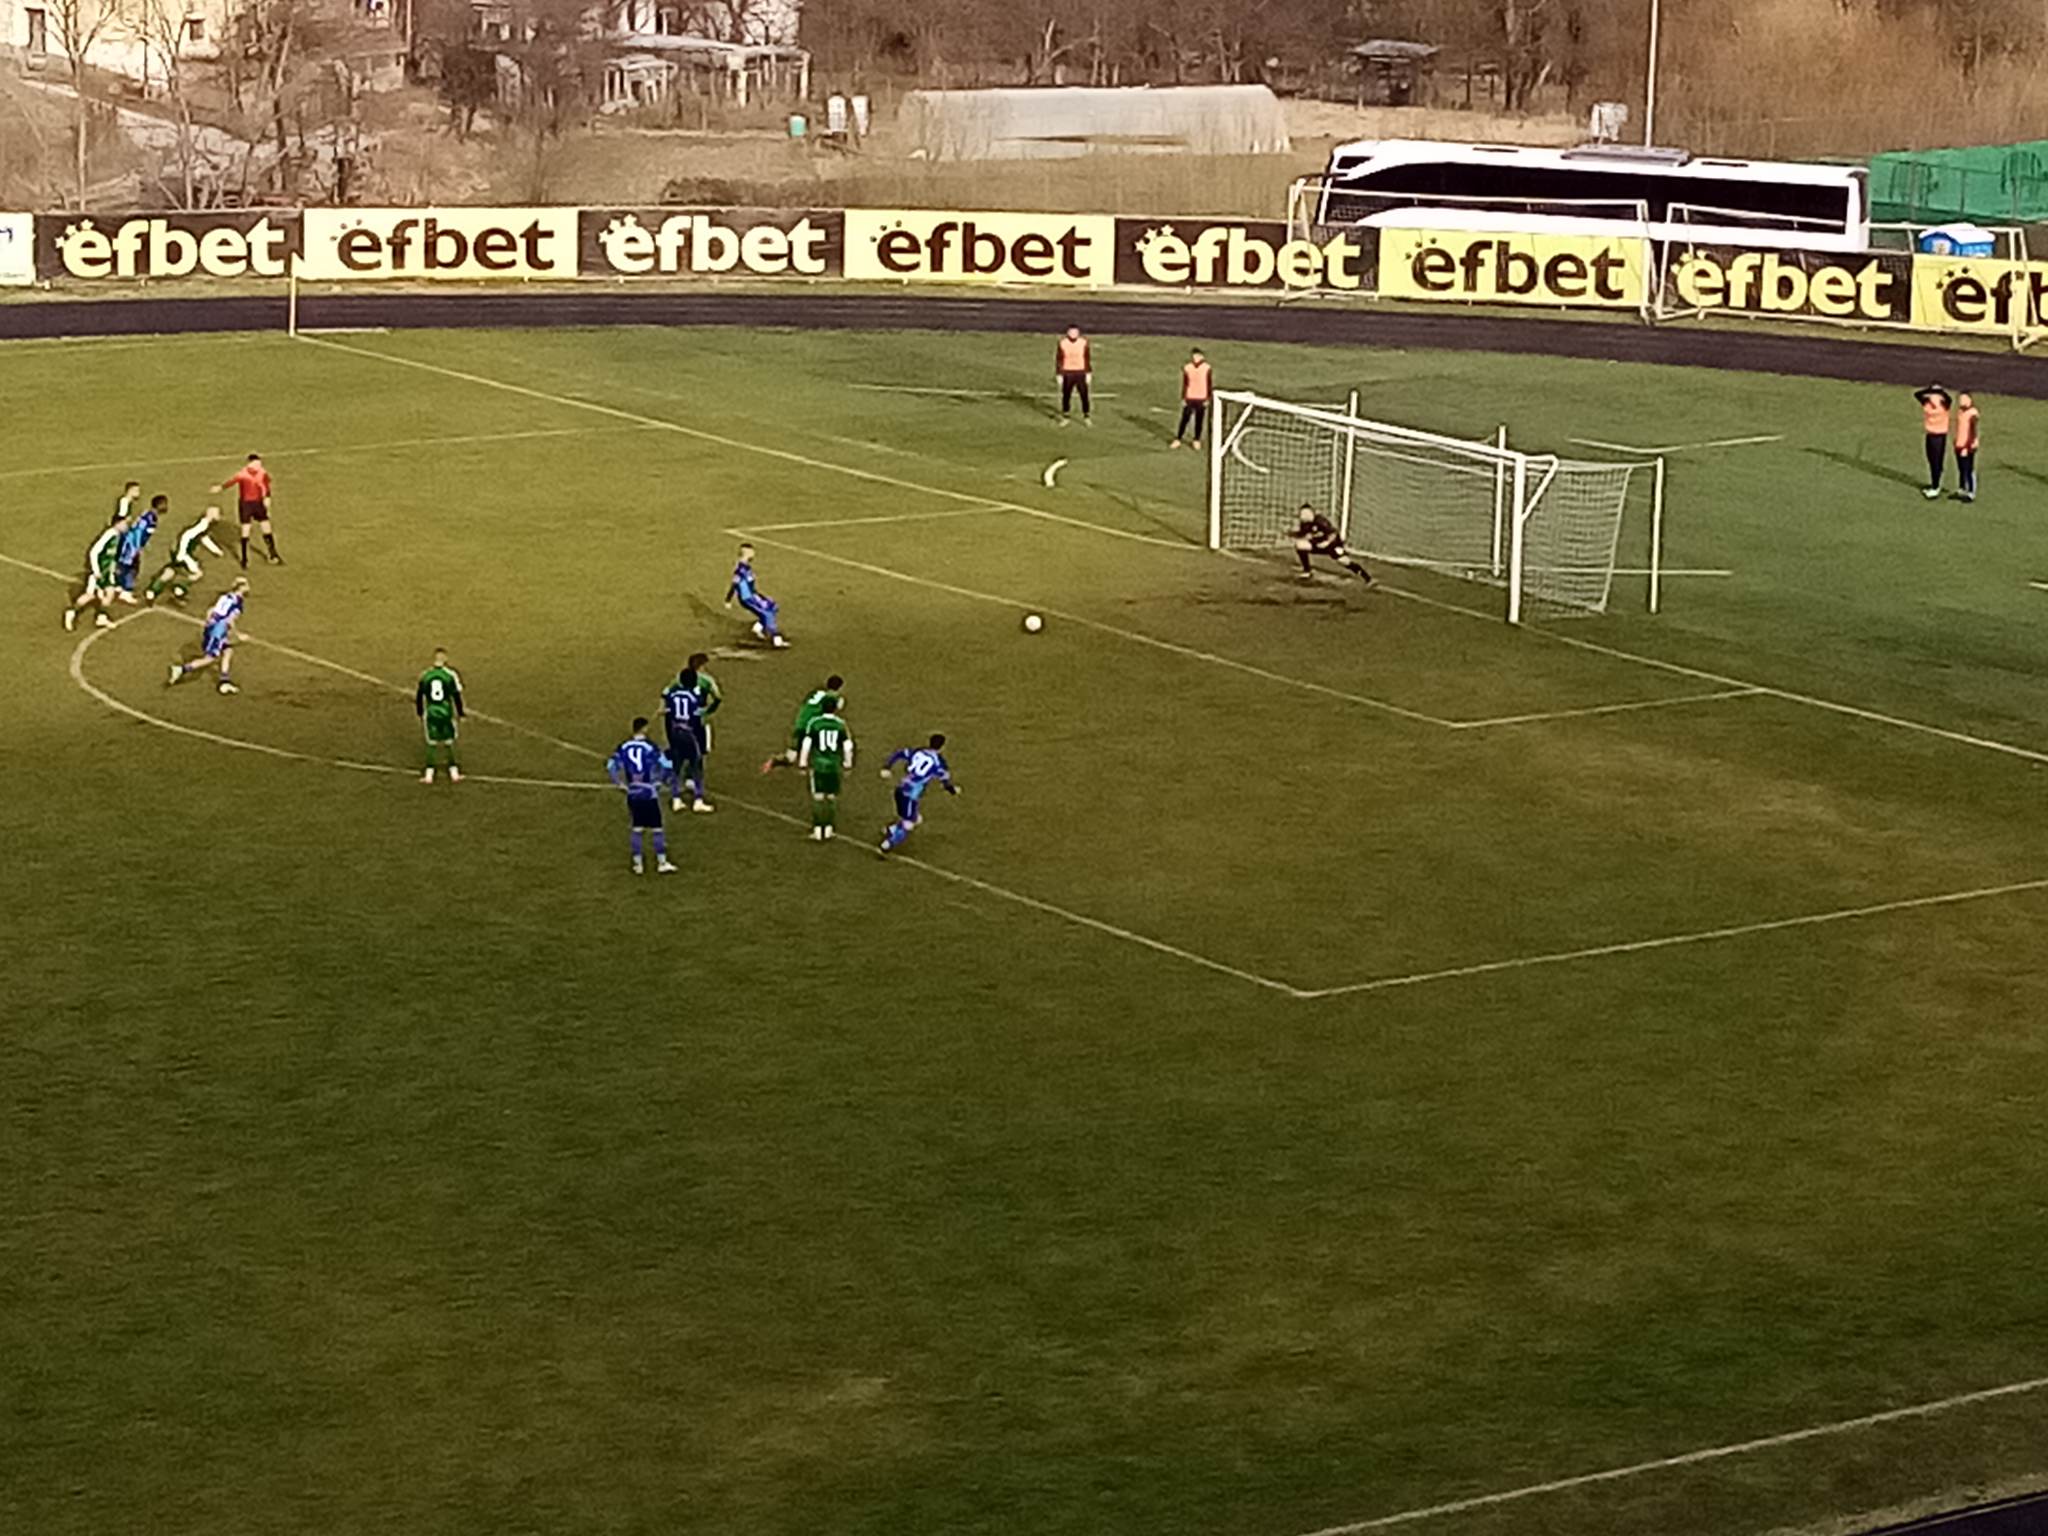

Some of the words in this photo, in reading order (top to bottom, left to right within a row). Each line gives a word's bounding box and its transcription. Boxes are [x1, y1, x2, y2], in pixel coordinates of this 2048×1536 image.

[63, 217, 285, 277] efbet
[337, 217, 555, 271] efbet
[605, 215, 826, 273] efbet
[876, 220, 1092, 278] efbet
[1142, 227, 1361, 288] efbet
[1411, 240, 1625, 300] efbet
[1676, 252, 1893, 318] efbet
[430, 679, 444, 701] 8
[673, 696, 690, 720] 11
[818, 729, 839, 752] 14
